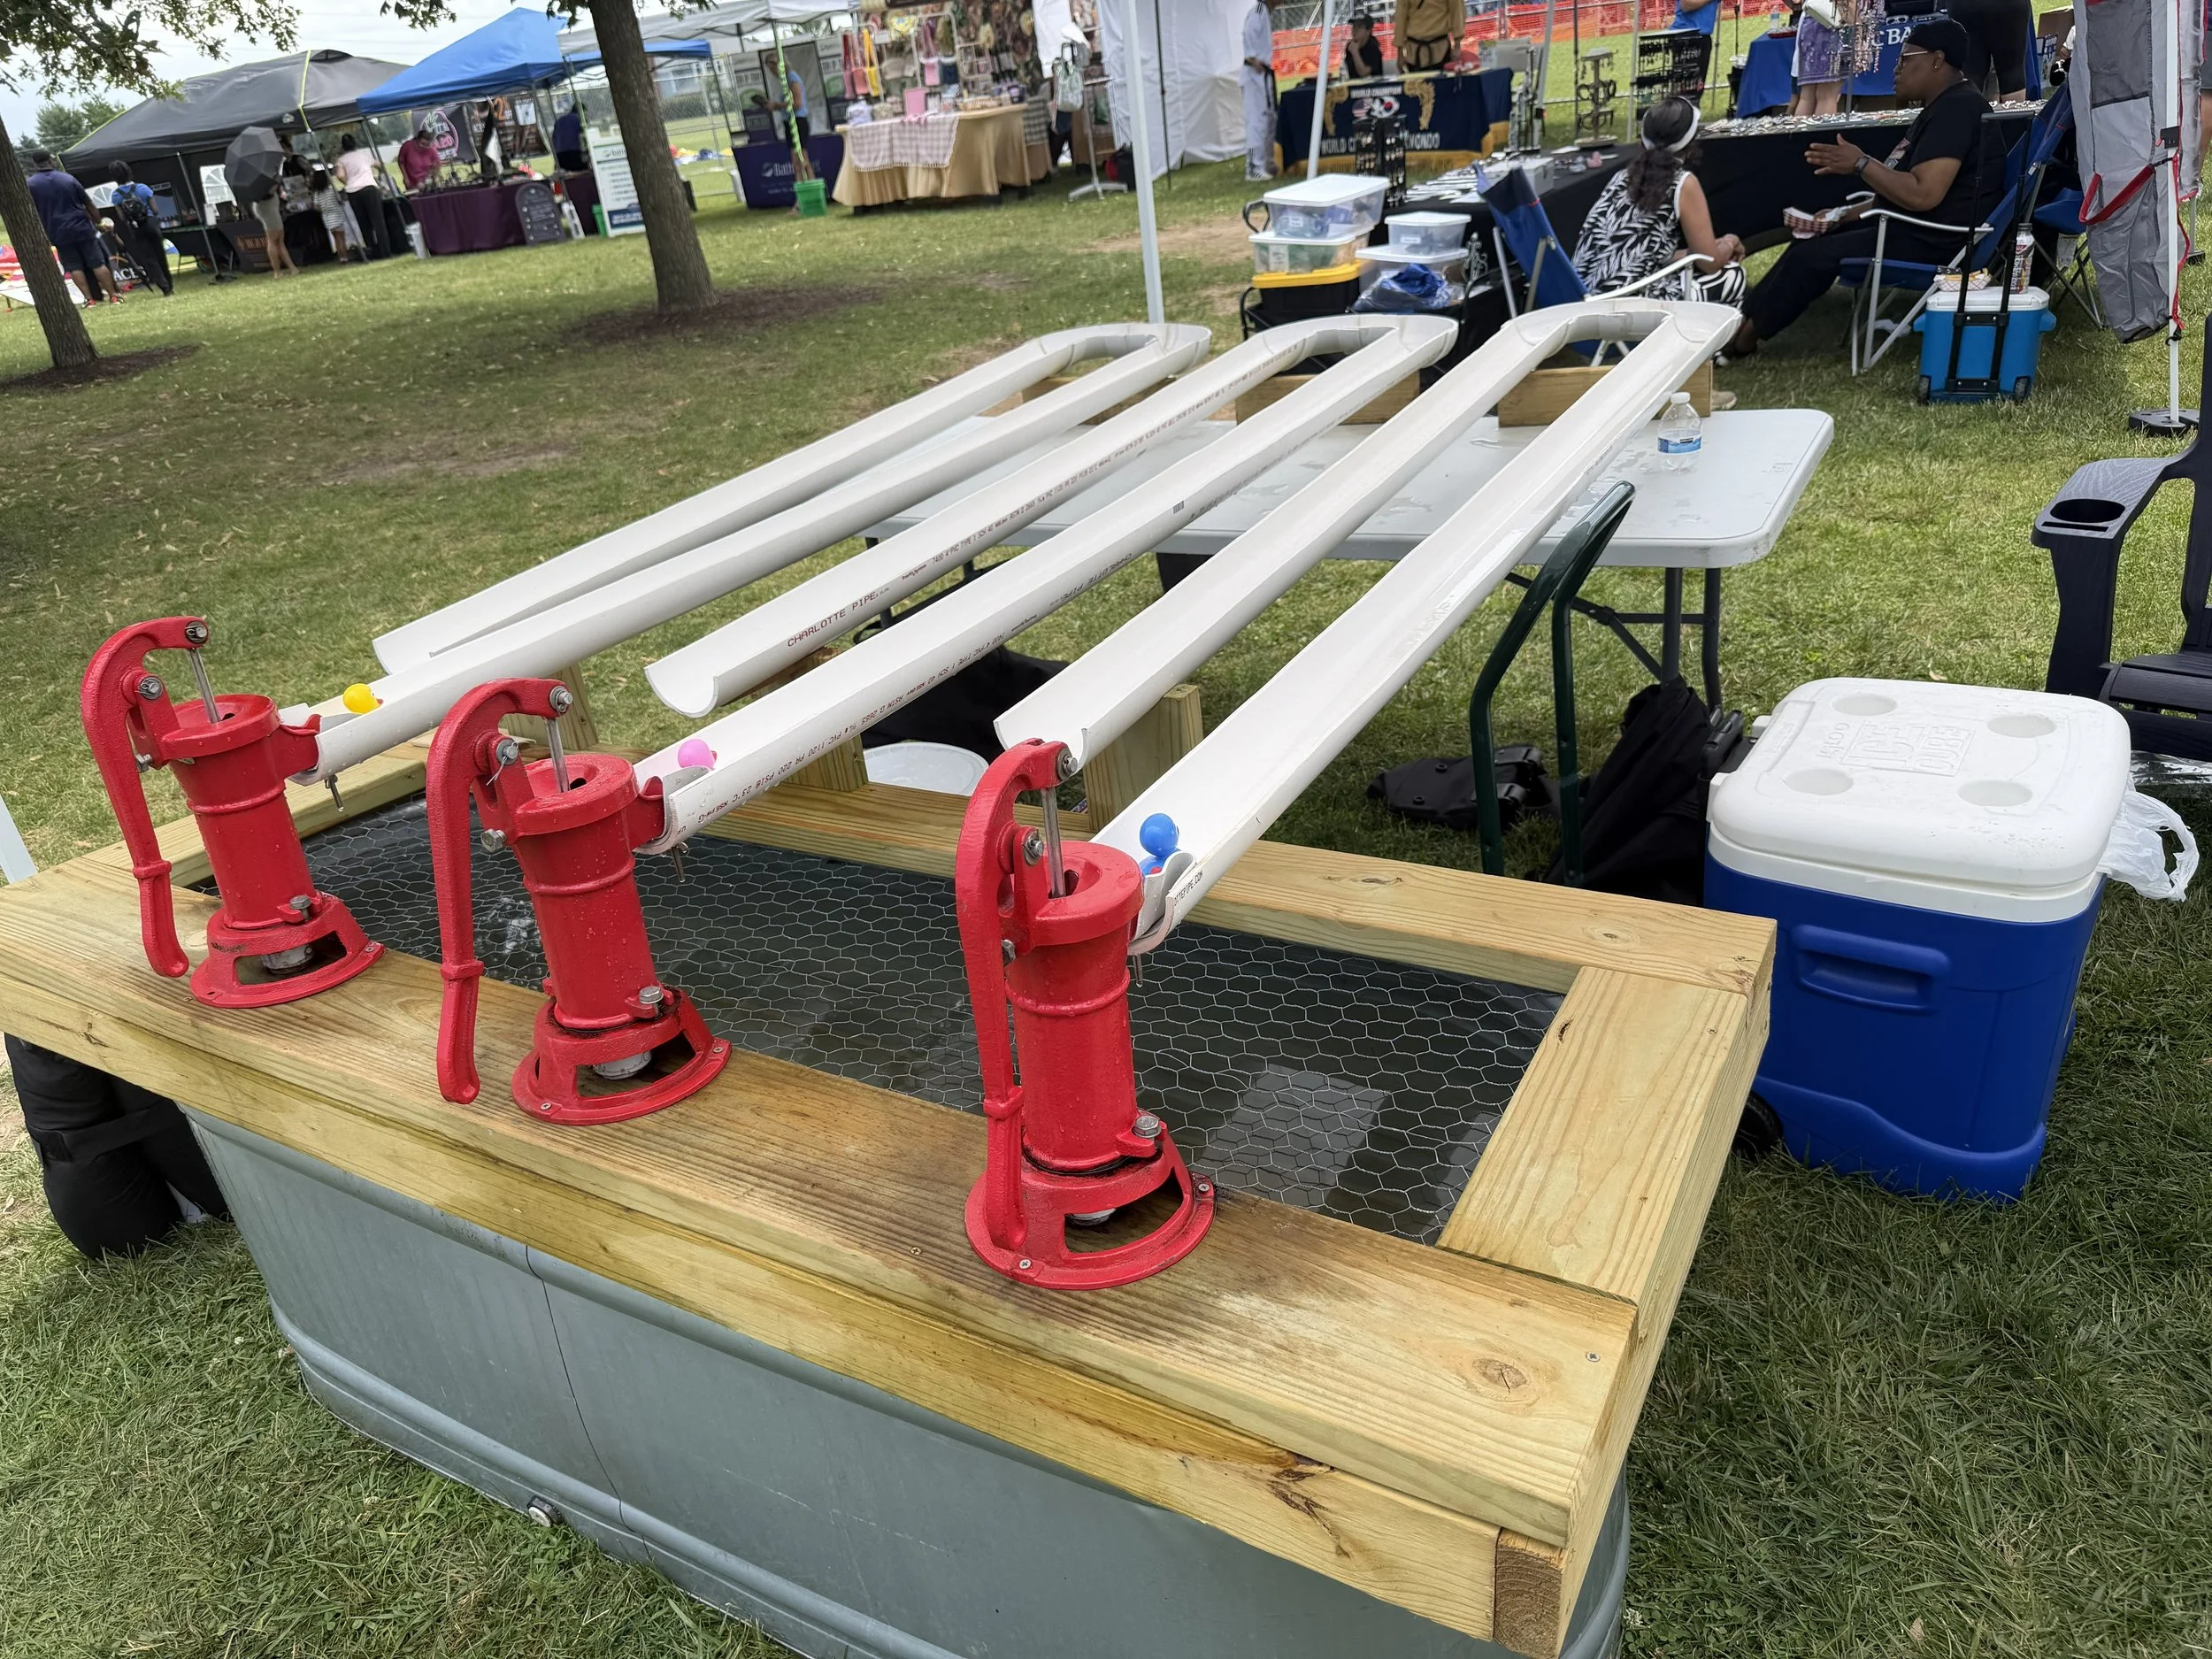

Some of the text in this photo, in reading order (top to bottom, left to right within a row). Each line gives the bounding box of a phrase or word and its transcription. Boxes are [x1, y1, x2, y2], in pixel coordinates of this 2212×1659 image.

[1321, 136, 1347, 153] WORLD
[1087, 553, 1133, 585] CHARLOTTE
[788, 609, 846, 647] CHARLOTTE
[852, 591, 876, 611] PIPE
[938, 666, 949, 677] SCH
[879, 704, 886, 713] D
[887, 694, 903, 709] ASTM
[861, 710, 878, 726] 2665
[828, 731, 842, 745] PVC
[808, 741, 825, 757] 1120
[1916, 726, 1974, 769] CUBE
[795, 752, 805, 764] PR
[778, 761, 793, 775] 220
